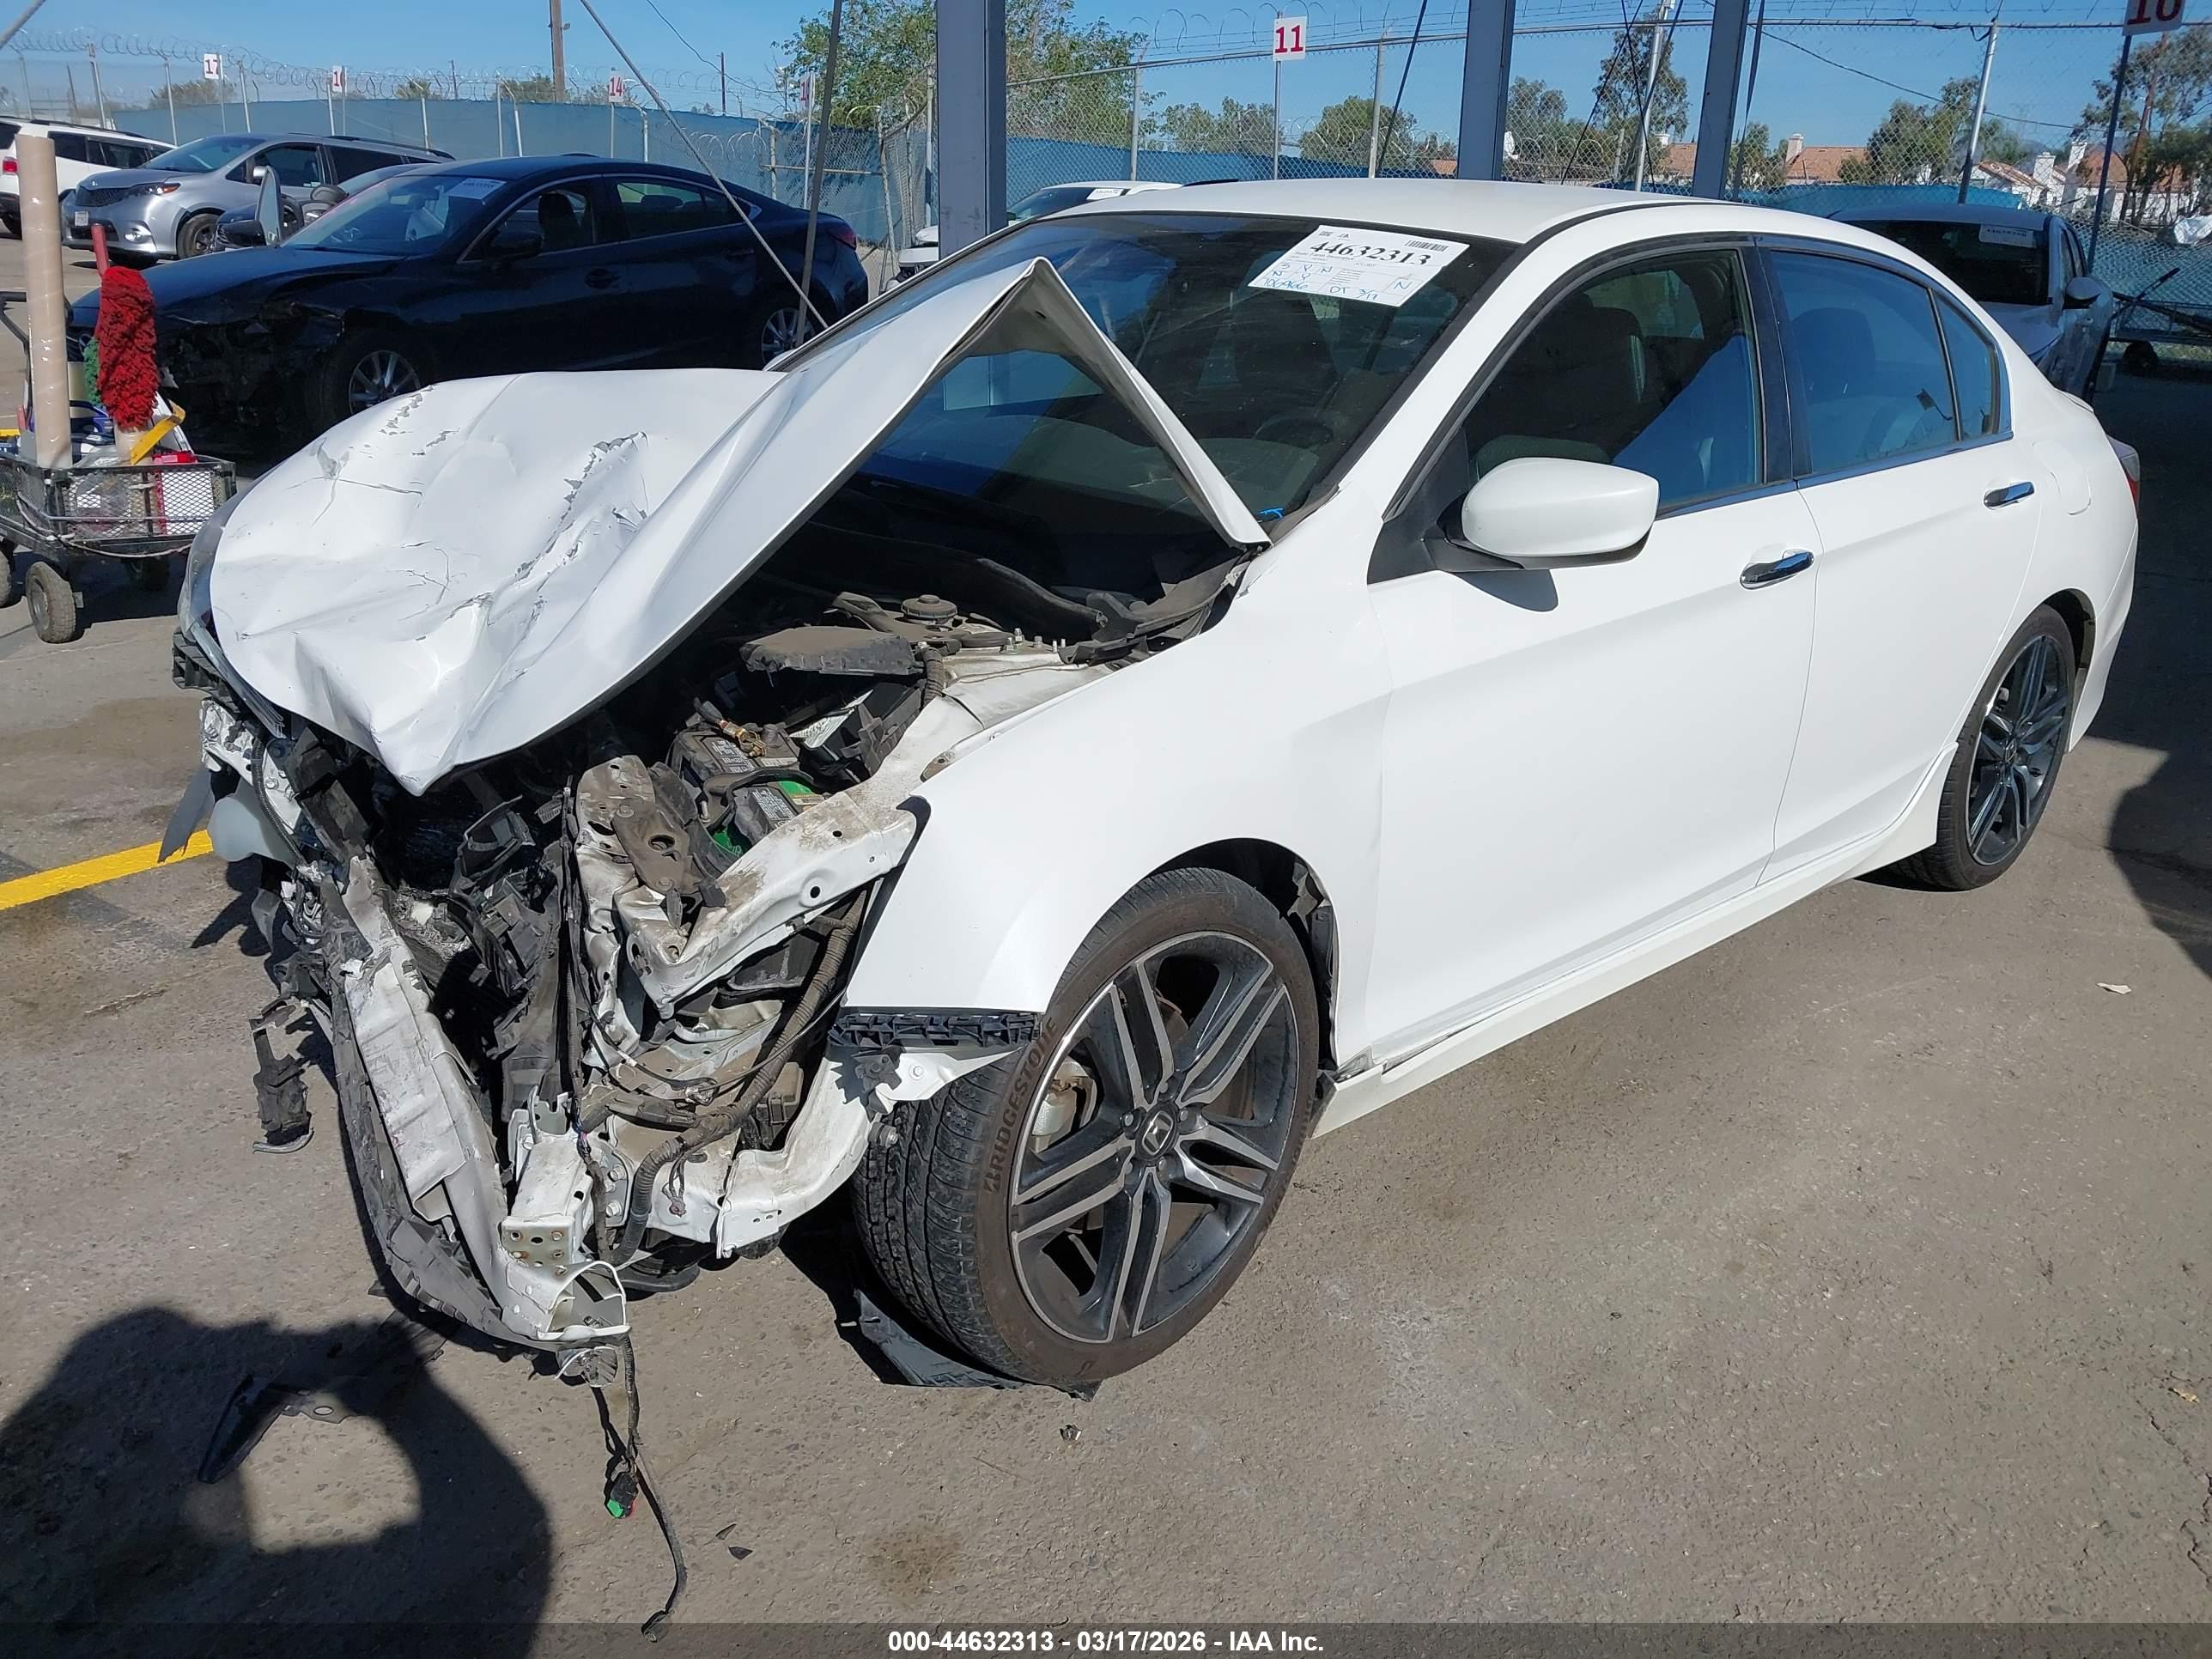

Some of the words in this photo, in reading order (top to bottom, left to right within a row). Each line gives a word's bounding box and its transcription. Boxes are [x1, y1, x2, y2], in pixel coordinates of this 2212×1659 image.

[1275, 25, 1304, 53] 11
[205, 59, 220, 75] 17
[610, 77, 623, 96] 14
[1310, 241, 1432, 264] 44632313
[1394, 282, 1413, 290] N
[982, 1017, 1057, 1194] BRIDGESTONE
